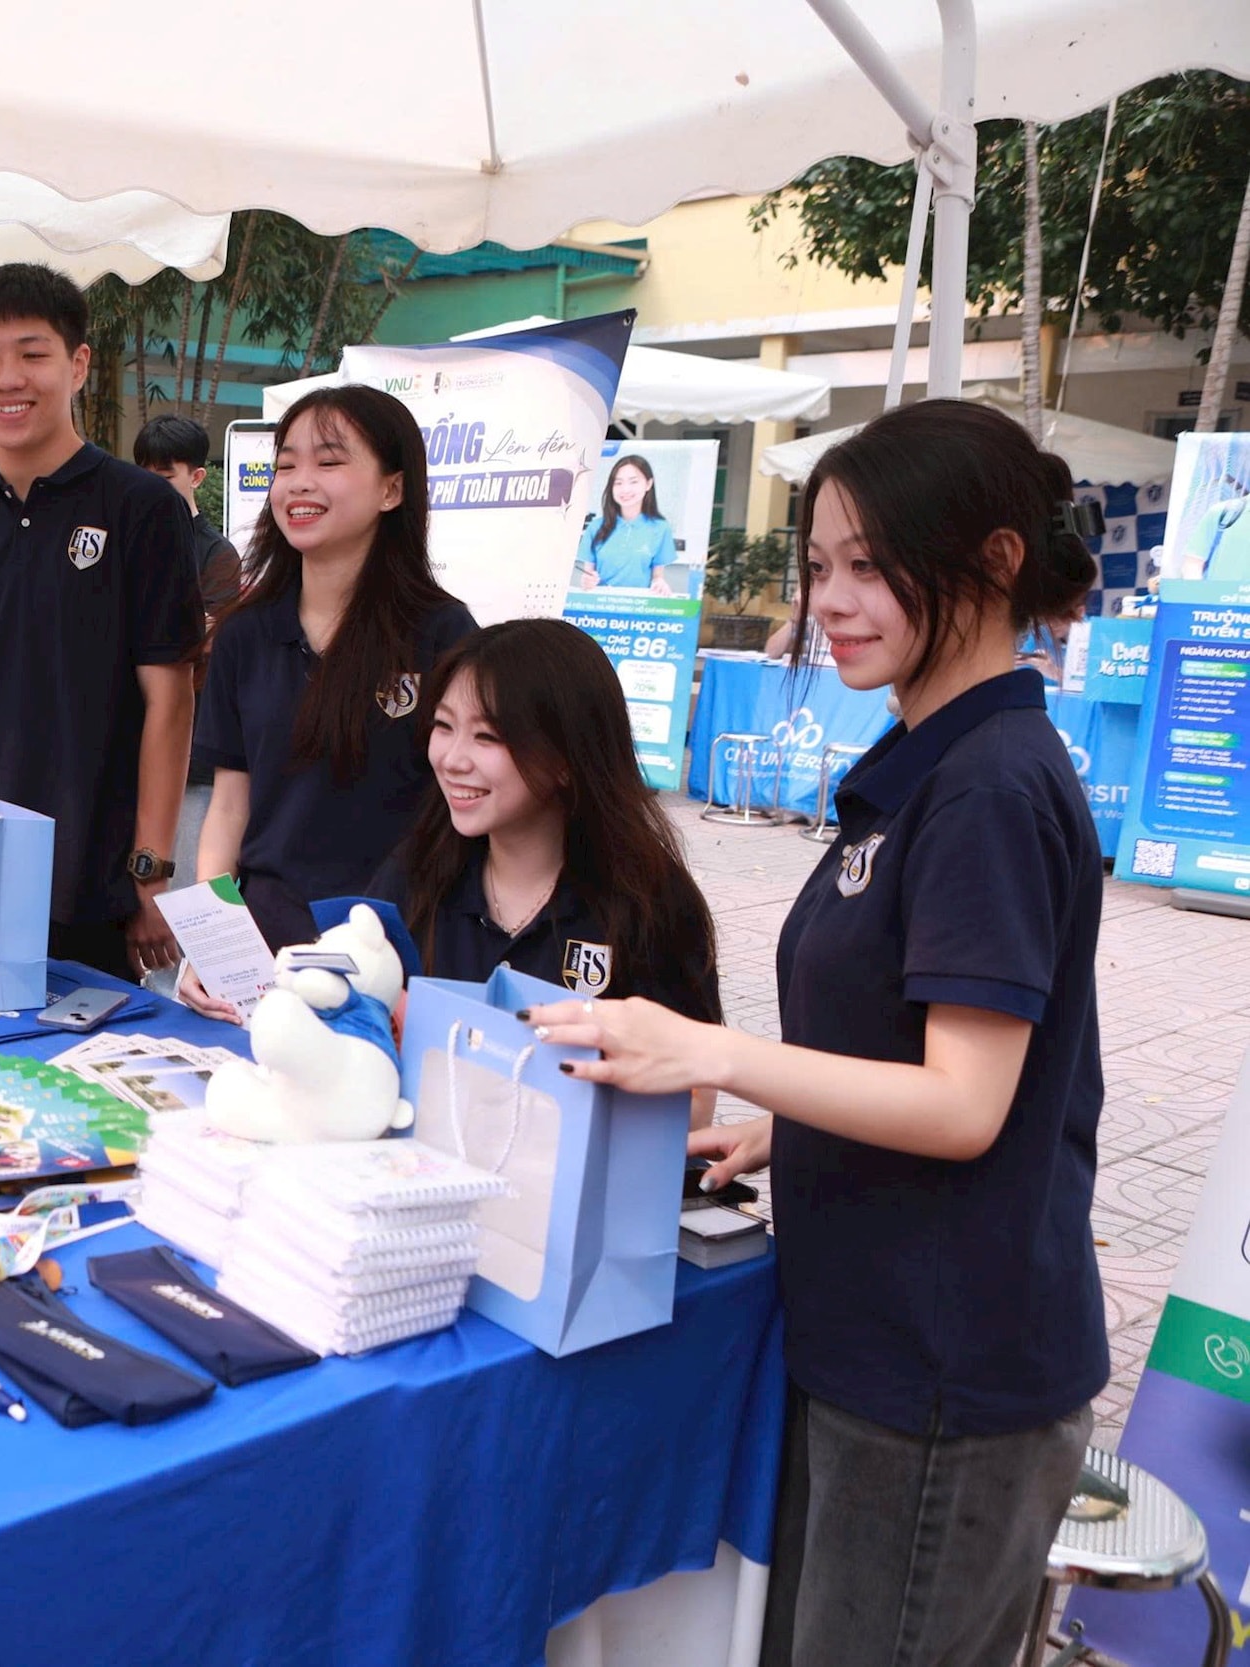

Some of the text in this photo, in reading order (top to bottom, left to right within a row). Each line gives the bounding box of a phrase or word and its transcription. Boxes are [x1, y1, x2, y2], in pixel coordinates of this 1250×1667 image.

[385, 377, 413, 393] VNU
[483, 428, 532, 464] Lên
[538, 429, 576, 462] đến
[243, 472, 270, 487] CÙNG
[431, 469, 551, 505] PHÍ TOÀN KHOÁ
[609, 620, 629, 632] ĐẠI
[630, 621, 656, 634] HỌC
[657, 622, 684, 634] CMC
[607, 635, 668, 659] CMC 96
